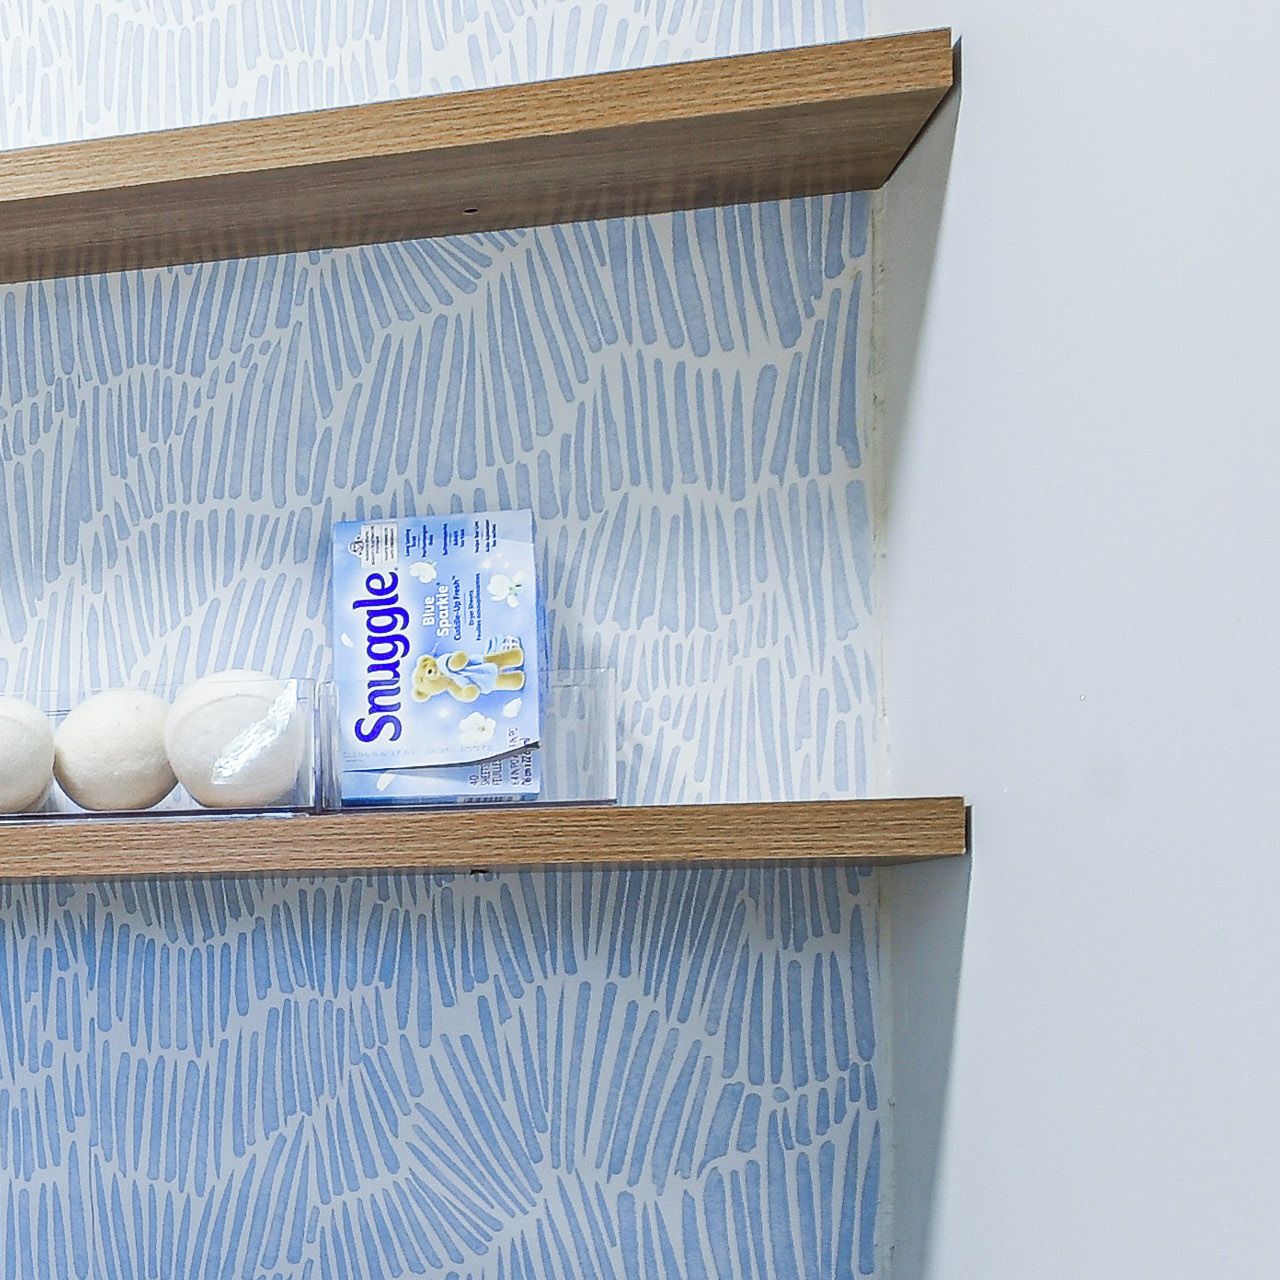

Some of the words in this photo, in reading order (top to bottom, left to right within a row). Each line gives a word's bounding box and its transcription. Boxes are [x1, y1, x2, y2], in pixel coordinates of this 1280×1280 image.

[422, 596, 435, 626] Blue
[436, 585, 452, 638] Sparkle
[352, 571, 410, 743] Snuggle
